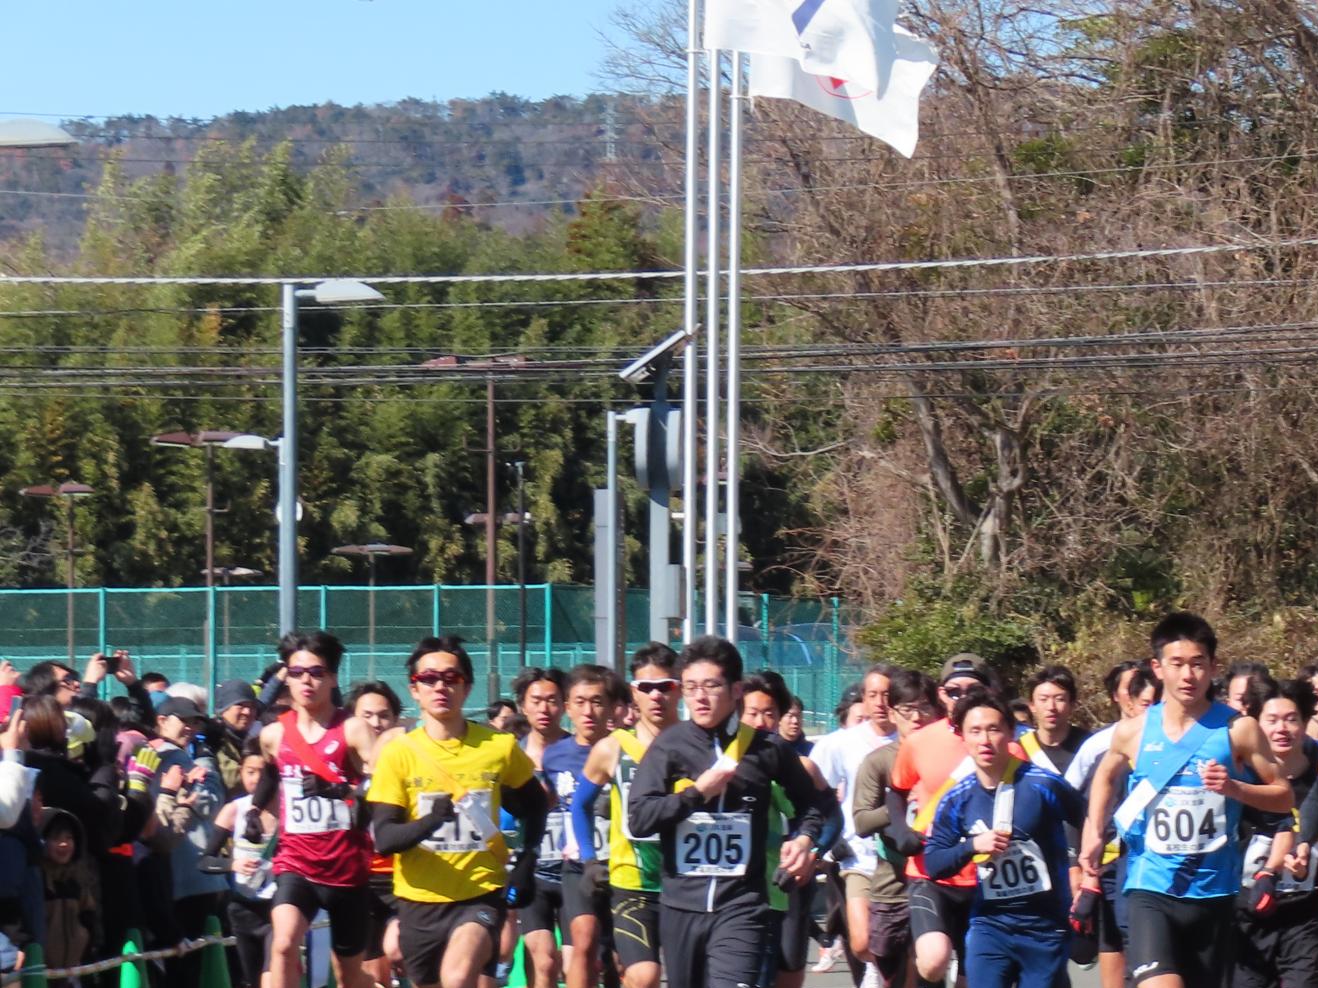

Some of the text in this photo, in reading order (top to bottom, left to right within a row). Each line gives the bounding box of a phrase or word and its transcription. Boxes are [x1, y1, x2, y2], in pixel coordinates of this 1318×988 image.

[291, 797, 338, 823] 501
[1154, 808, 1217, 842] 604
[683, 833, 744, 865] 205
[985, 855, 1039, 890] 206
